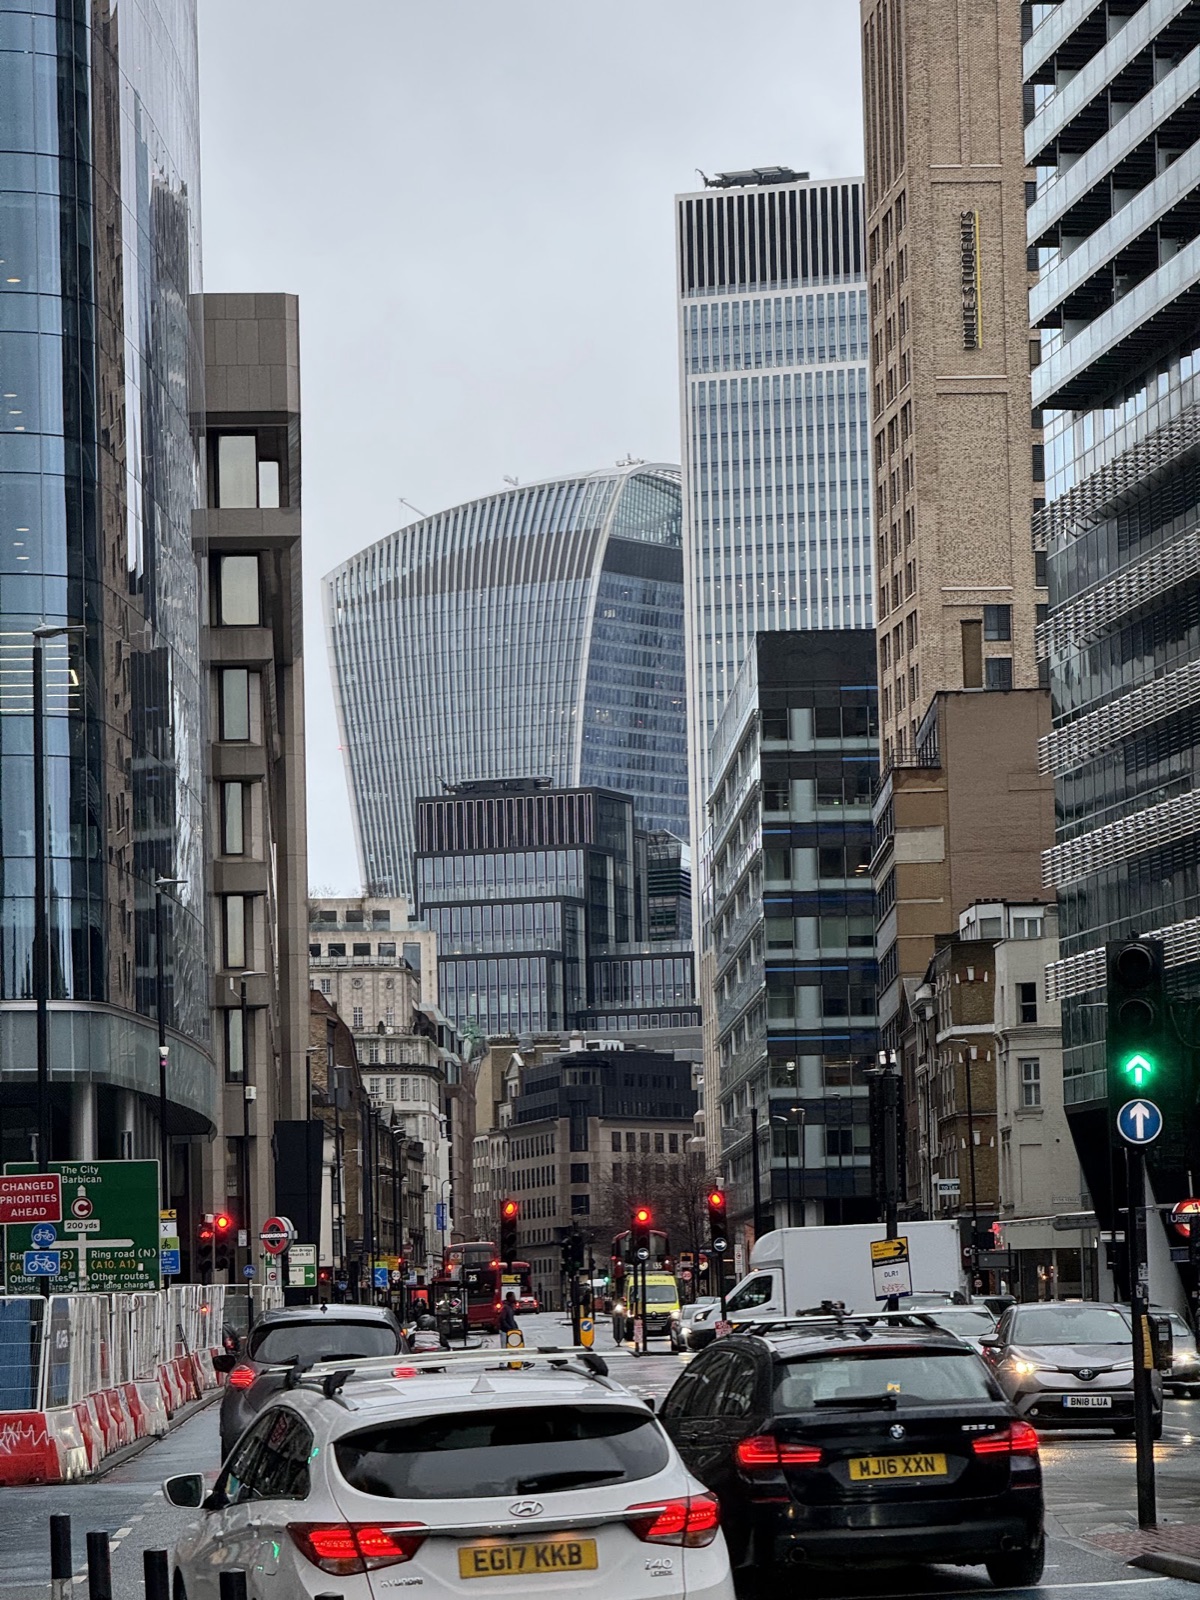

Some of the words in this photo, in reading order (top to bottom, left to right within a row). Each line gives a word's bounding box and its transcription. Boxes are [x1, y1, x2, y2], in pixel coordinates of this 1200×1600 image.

[960, 210, 976, 296] STUDENTS
[963, 300, 977, 350] UNITE
[61, 1165, 77, 1174] The
[80, 1165, 99, 1175] City
[61, 1175, 102, 1184] Barbican
[1, 1181, 54, 1192] CHANGED
[0, 1193, 58, 1205] PRIORITIES
[10, 1207, 47, 1217] AHEAD
[84, 1222, 98, 1230] yds
[91, 1250, 111, 1259] Ring
[114, 1249, 135, 1258] road
[138, 1248, 157, 1258] (N)
[120, 1259, 136, 1269] A1)
[9, 1274, 36, 1283] Other
[49, 1274, 69, 1282] utes
[91, 1272, 117, 1281] Other
[120, 1271, 150, 1280] routes
[468, 1274, 478, 1282] 25
[883, 1270, 899, 1278] DLR1
[1091, 1397, 1108, 1406] LUA
[859, 1458, 898, 1477] MJ16
[902, 1456, 936, 1474] XXN
[473, 1545, 527, 1572] EG17
[534, 1542, 583, 1568] KKB
